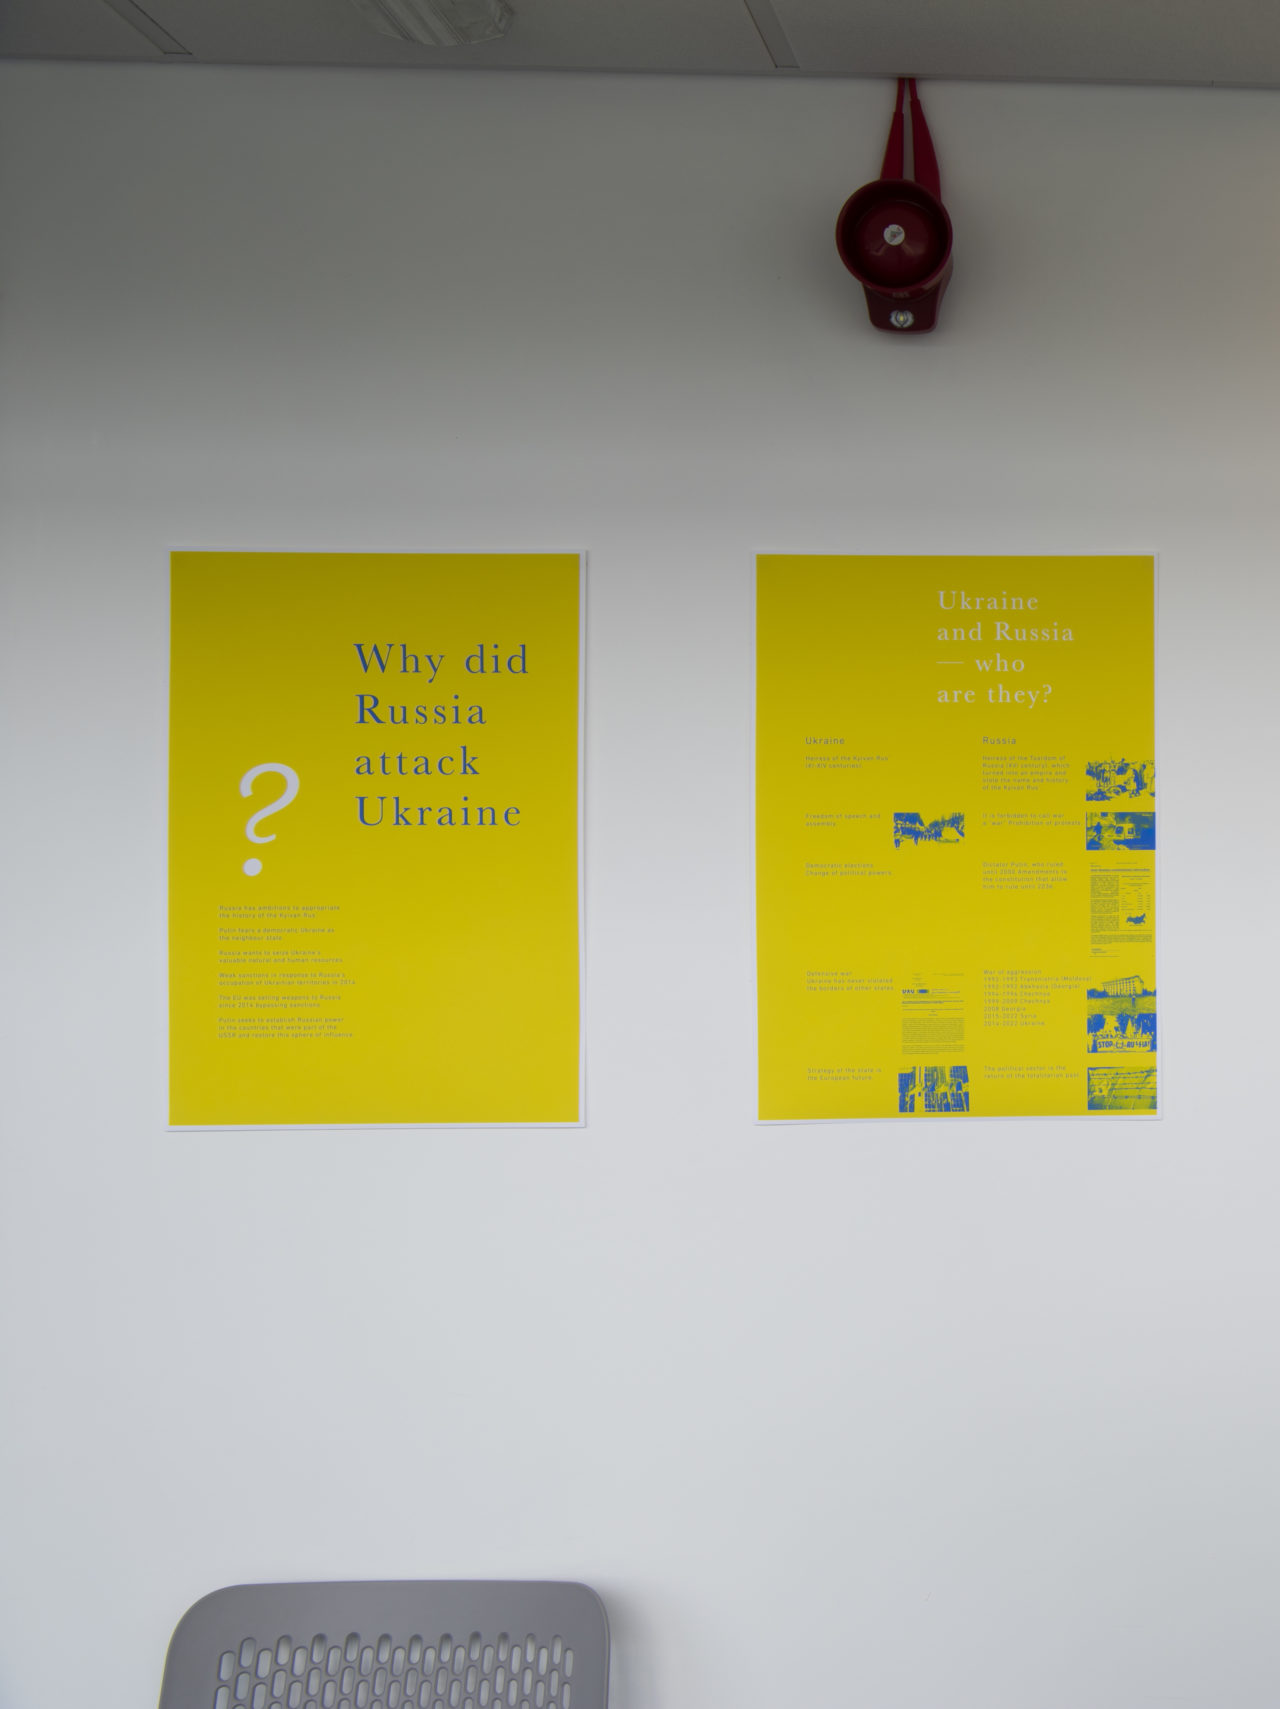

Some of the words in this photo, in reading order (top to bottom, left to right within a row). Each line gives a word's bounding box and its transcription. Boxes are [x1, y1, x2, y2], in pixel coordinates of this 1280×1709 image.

[937, 590, 1039, 610] Ukraine
[937, 621, 983, 641] and
[994, 621, 1074, 641] Russia
[353, 643, 446, 683] Why
[464, 643, 529, 674] did
[975, 652, 1025, 672] who
[354, 693, 487, 724] Russia
[937, 688, 976, 703] are
[987, 683, 1052, 709] they?
[805, 736, 845, 745] Ukraine
[982, 736, 1017, 745] Russia
[355, 745, 480, 775] attack
[239, 762, 300, 877] ?
[354, 795, 521, 826] Ukraine
